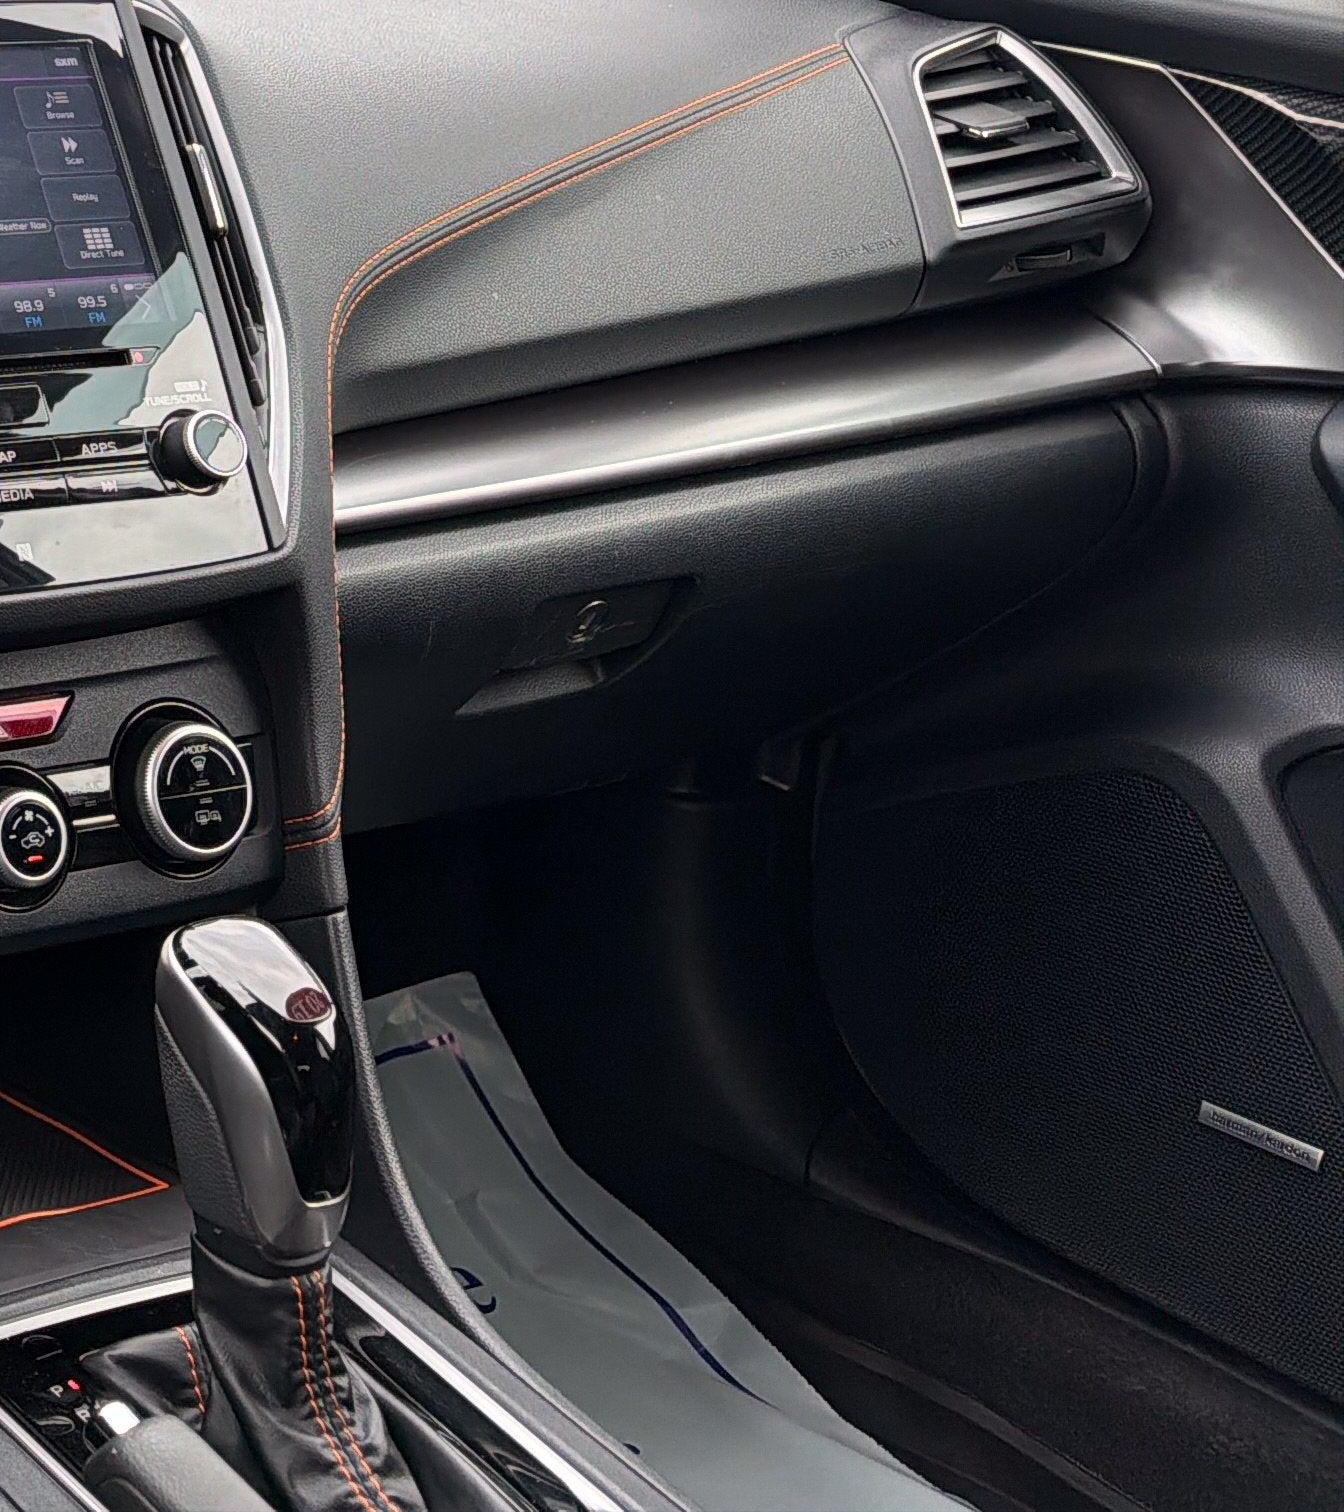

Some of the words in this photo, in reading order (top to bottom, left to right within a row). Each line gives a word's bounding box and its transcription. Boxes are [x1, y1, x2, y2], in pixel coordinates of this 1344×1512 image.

[64, 156, 85, 165] Scan
[47, 287, 56, 298] 5
[14, 299, 45, 313] 98.9
[77, 295, 107, 309] 99.5
[24, 316, 43, 328] FM
[87, 311, 106, 324] FM
[143, 392, 213, 406] TUNE/SCROLL
[80, 440, 118, 456] APPS
[182, 744, 210, 756] MODE
